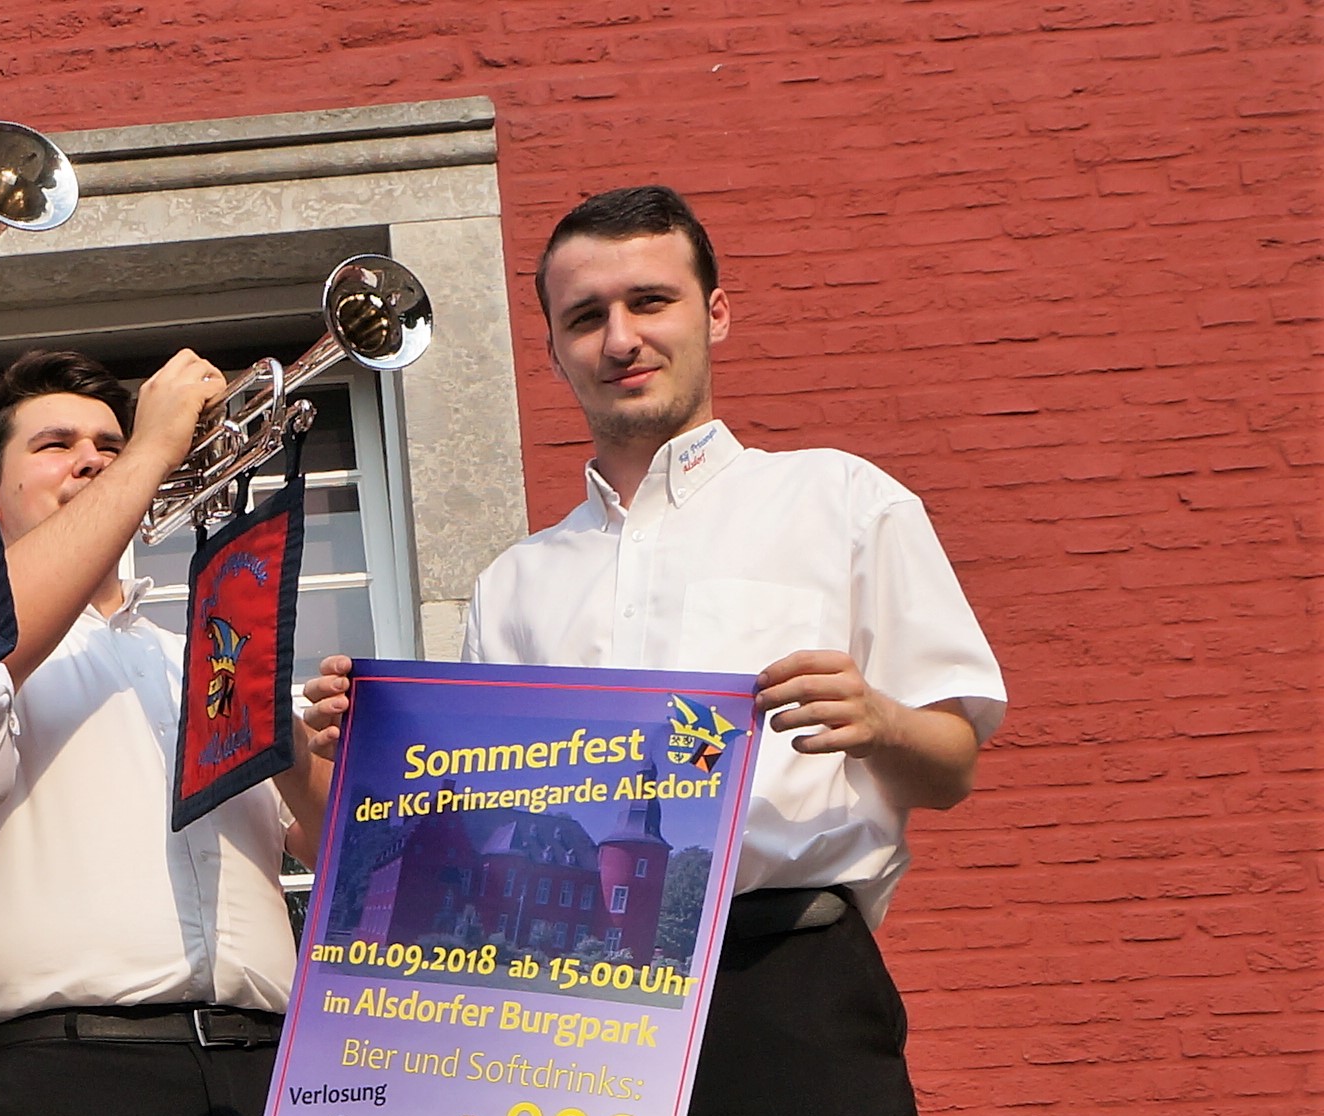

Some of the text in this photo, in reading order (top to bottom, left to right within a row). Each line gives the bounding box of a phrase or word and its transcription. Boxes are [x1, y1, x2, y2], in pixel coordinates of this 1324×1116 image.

[405, 730, 644, 778] Sommerfest
[356, 773, 720, 821] der KG Prinzengarde Alsdorf
[311, 941, 700, 996] am 01.09.2018 ab 15.00 Uhr
[324, 989, 658, 1048] im Alsdorfer Burgpark
[289, 1084, 387, 1106] Verlosung
[343, 1040, 644, 1100] Bier und Softdrinks:
